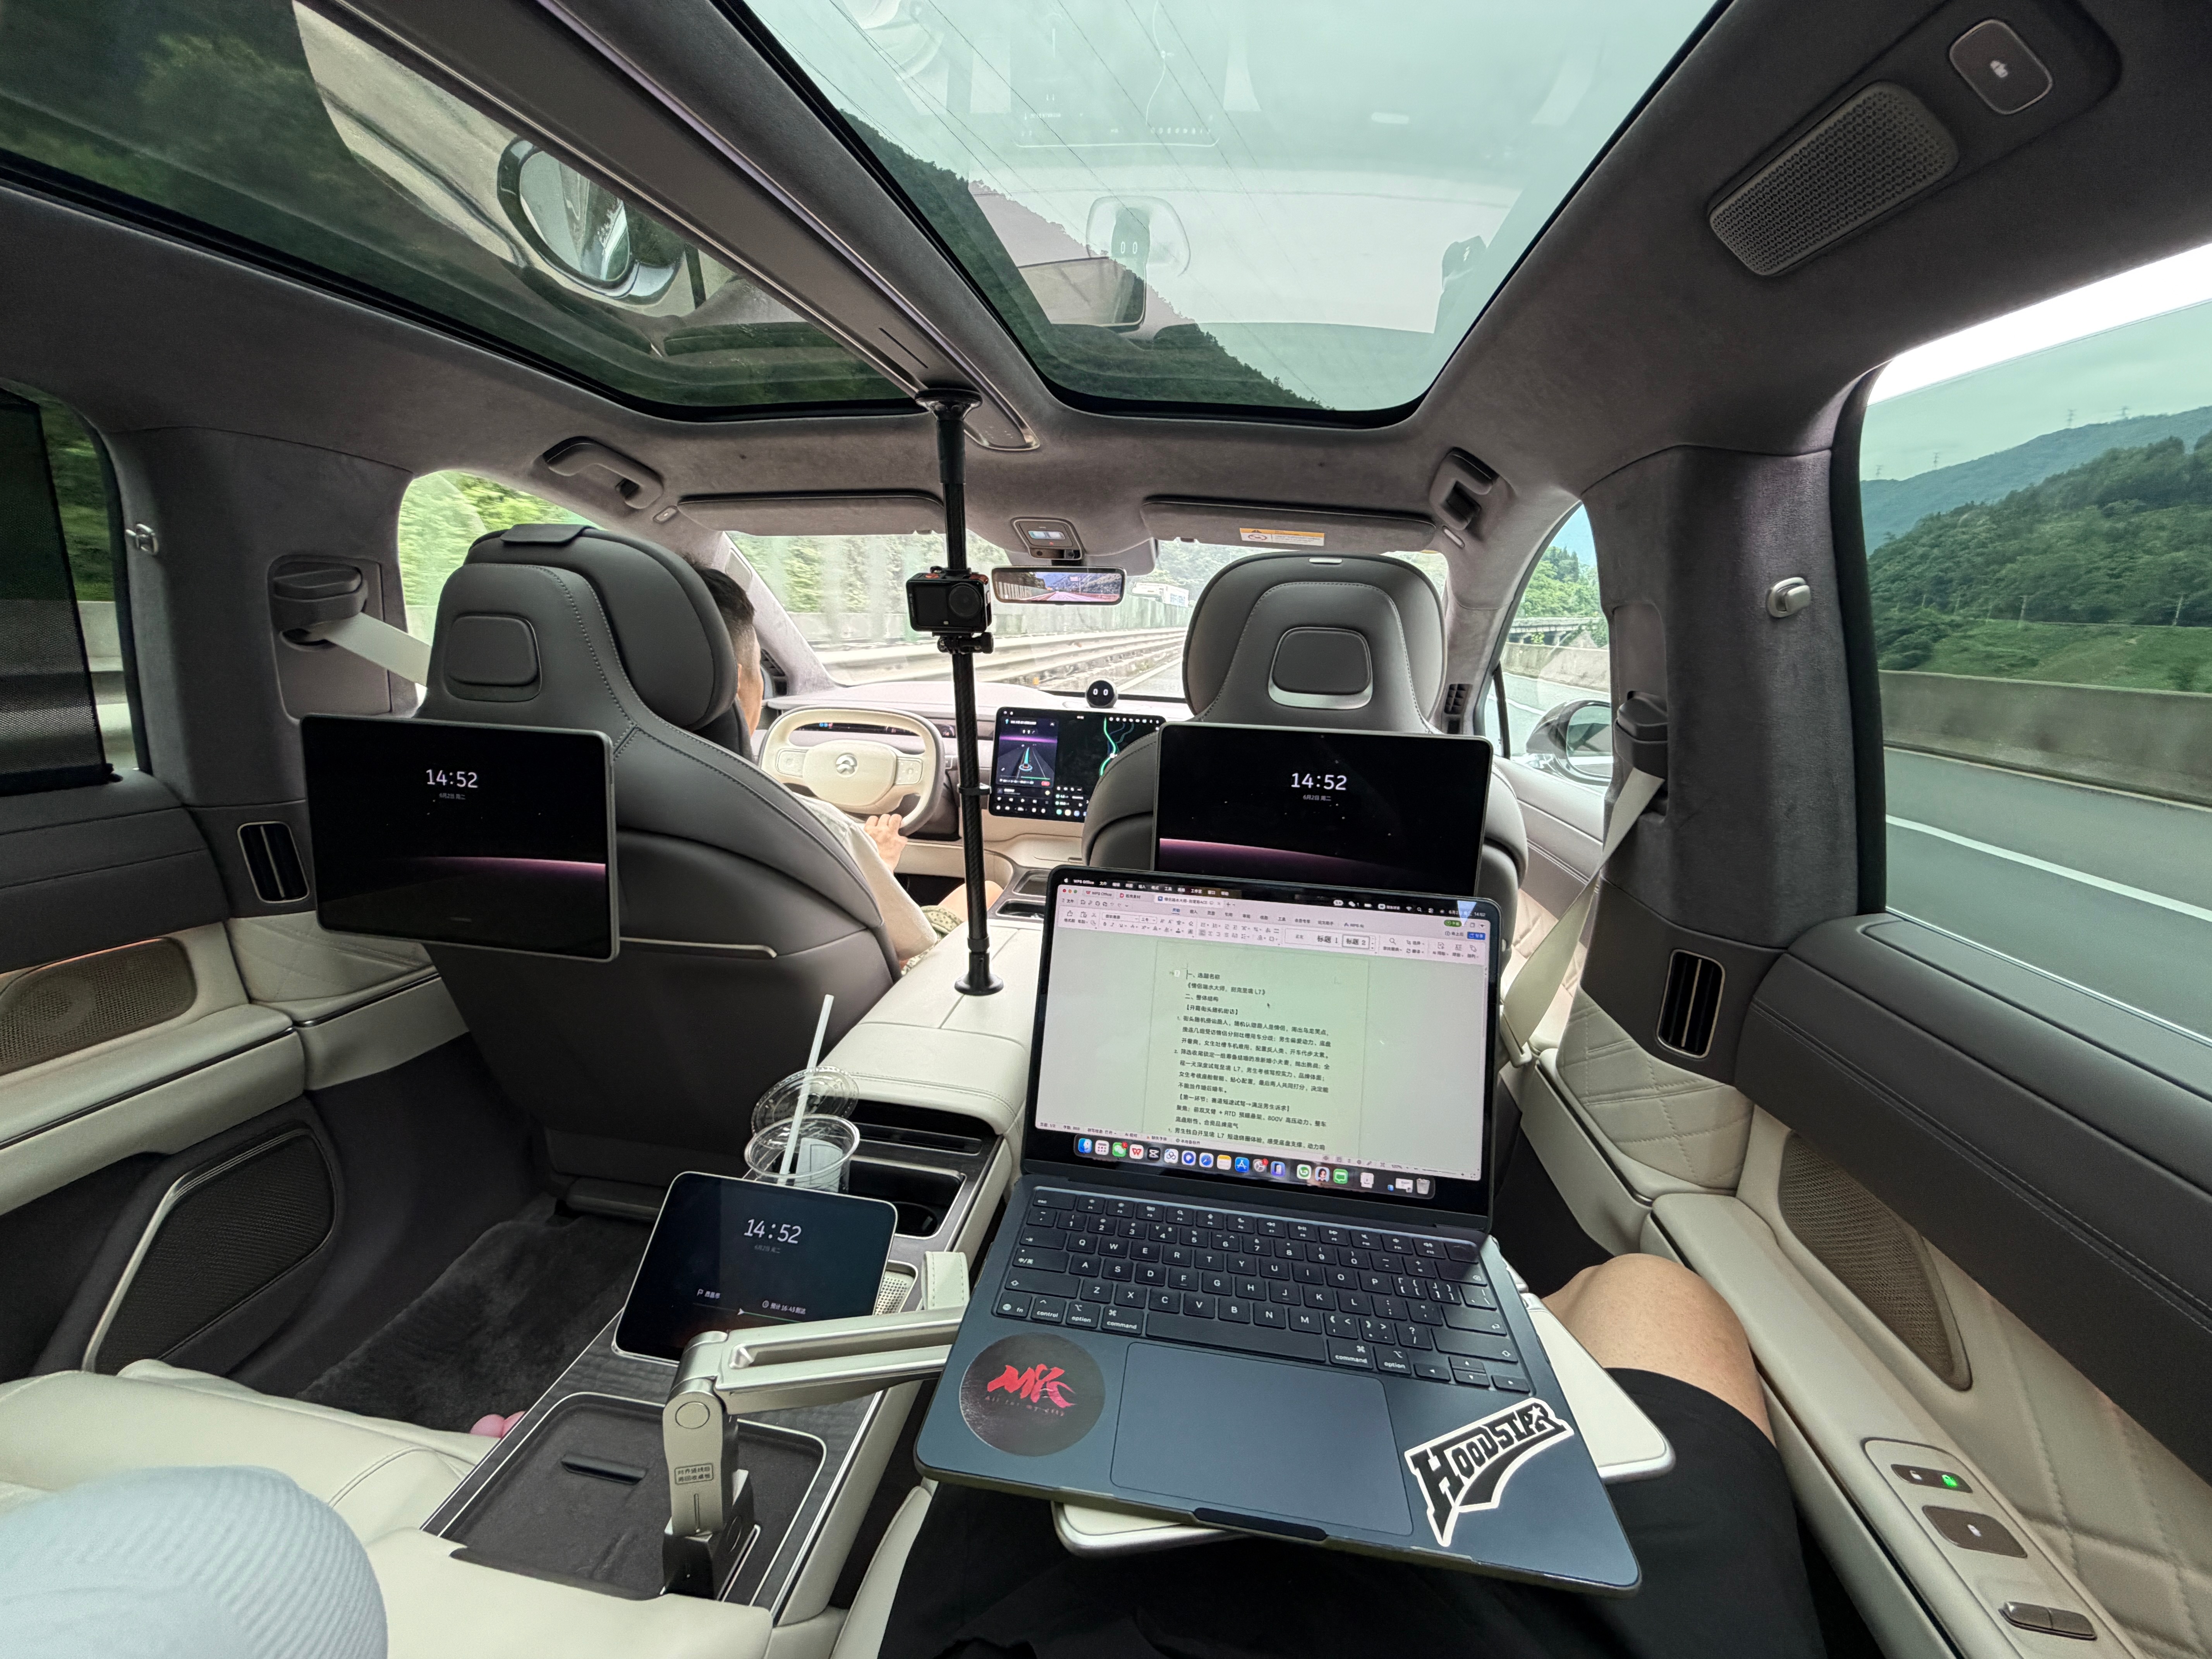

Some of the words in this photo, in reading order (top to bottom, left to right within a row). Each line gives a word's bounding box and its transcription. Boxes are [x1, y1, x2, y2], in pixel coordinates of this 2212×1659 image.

[426, 769, 478, 788] 14:52
[1291, 773, 1347, 790] 14:52
[1317, 935, 1331, 943] 标题
[744, 1219, 802, 1244] 14:52
